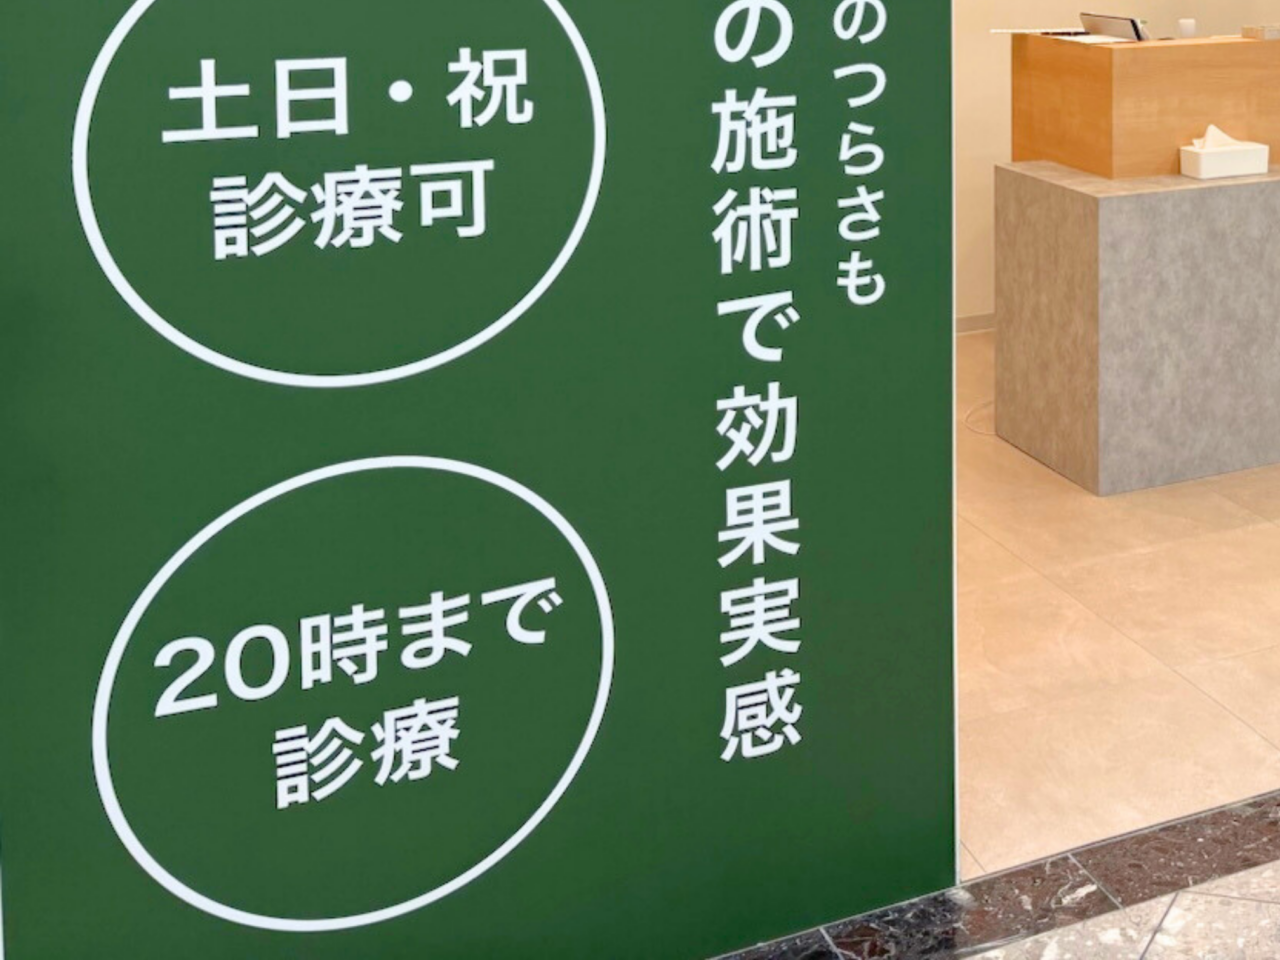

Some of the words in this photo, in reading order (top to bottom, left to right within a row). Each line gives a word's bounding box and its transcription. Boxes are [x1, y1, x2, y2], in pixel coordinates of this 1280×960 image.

[161, 47, 534, 144] 土日・祝
[209, 159, 495, 260] 診療可
[153, 577, 563, 718] 20時まで
[272, 697, 460, 809] 診療
